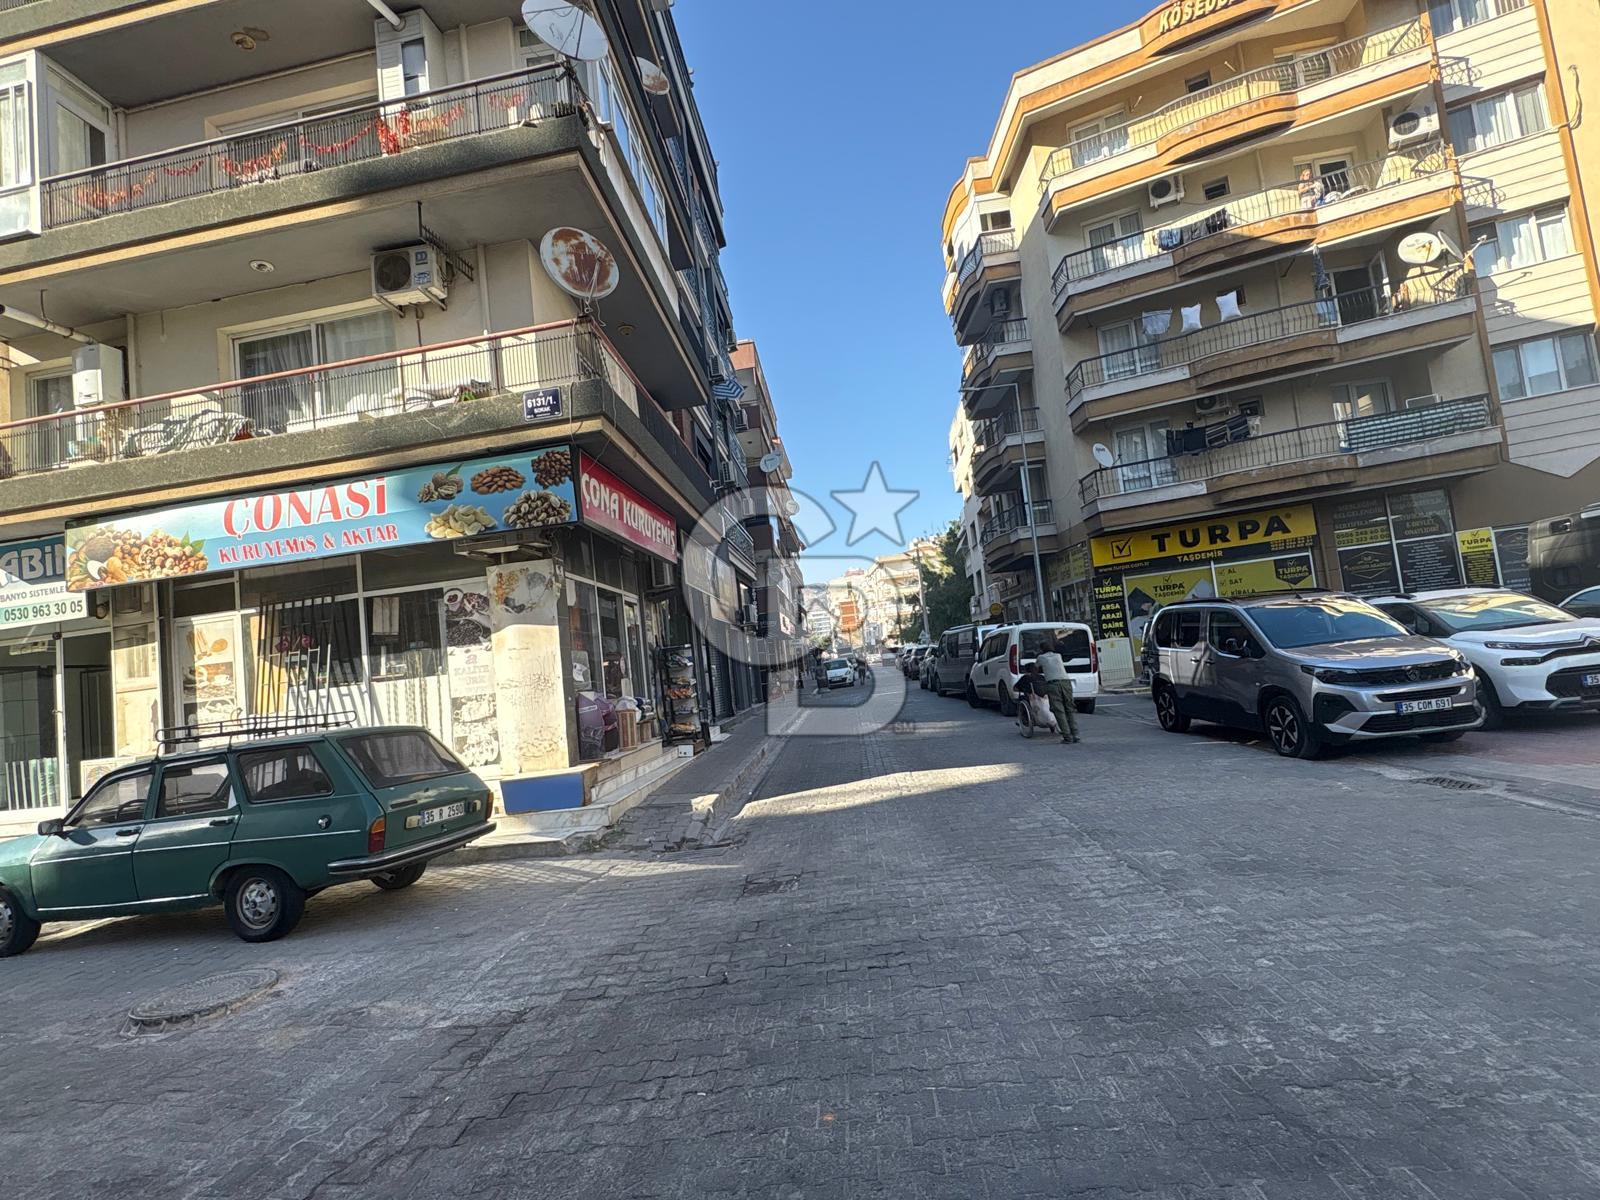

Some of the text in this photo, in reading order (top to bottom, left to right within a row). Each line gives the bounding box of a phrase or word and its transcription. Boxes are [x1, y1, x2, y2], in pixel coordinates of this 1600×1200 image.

[527, 396, 557, 408] 6131/1.
[581, 473, 676, 555] ÇONA KURUYEMİŞ
[1151, 515, 1291, 552] TURPA
[219, 525, 399, 564] KURUYEMİŞ & AKTAR
[1461, 536, 1492, 545] TURPA
[1177, 550, 1224, 563] TAŞDEMİR
[1277, 566, 1309, 575] TURPA
[1095, 584, 1122, 594] TURPA
[1153, 582, 1185, 593] TURPA
[4, 600, 83, 622] 0530 963 30 05
[1101, 603, 1120, 611] ARSA
[1101, 611, 1122, 621] ARAZİ
[1102, 621, 1124, 630] DAİRE
[1104, 630, 1125, 638] VİLLA
[1589, 675, 1600, 684] 35
[1403, 702, 1414, 712] 35
[1435, 698, 1450, 708] 691
[425, 804, 464, 823] 35 R 2590
